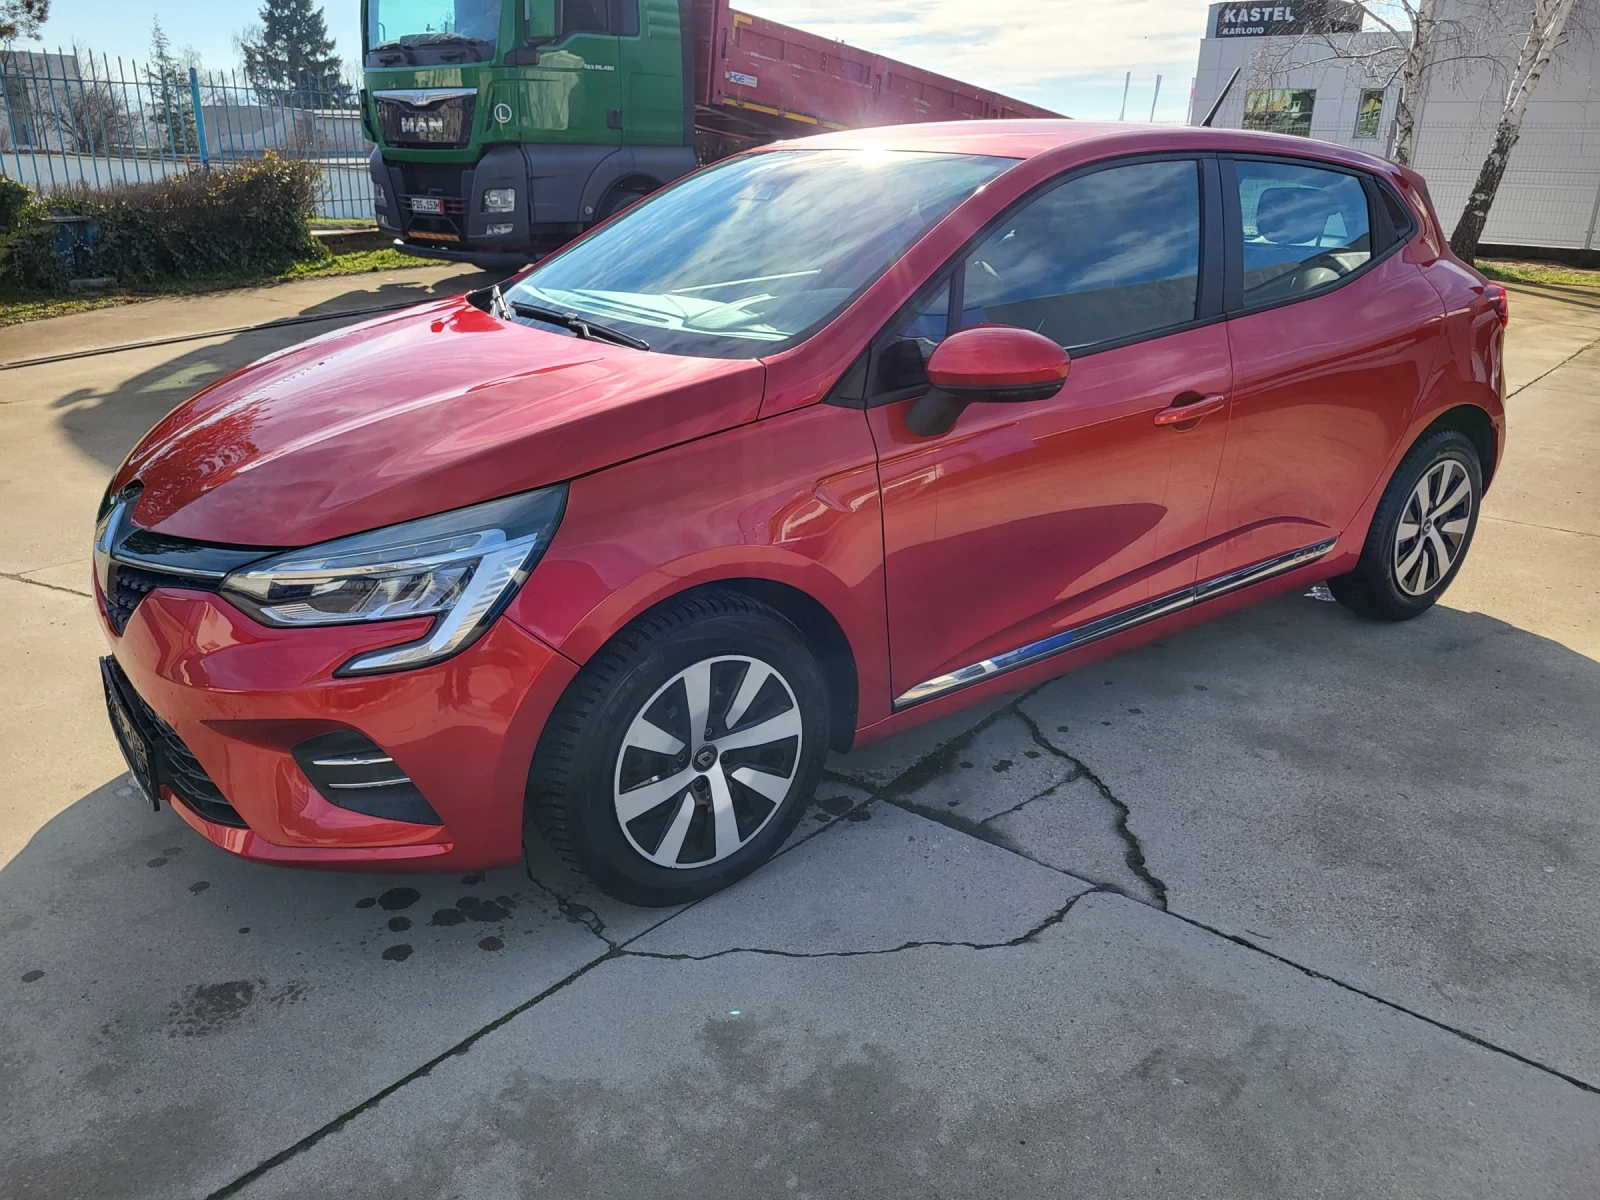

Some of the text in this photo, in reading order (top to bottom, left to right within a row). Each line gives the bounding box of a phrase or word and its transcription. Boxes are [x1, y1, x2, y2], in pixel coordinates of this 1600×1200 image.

[1224, 7, 1295, 23] KASTEL
[1222, 27, 1265, 35] KARLOVO
[498, 107, 507, 120] L
[401, 117, 444, 133] MAN
[1294, 544, 1327, 562] CLIO
